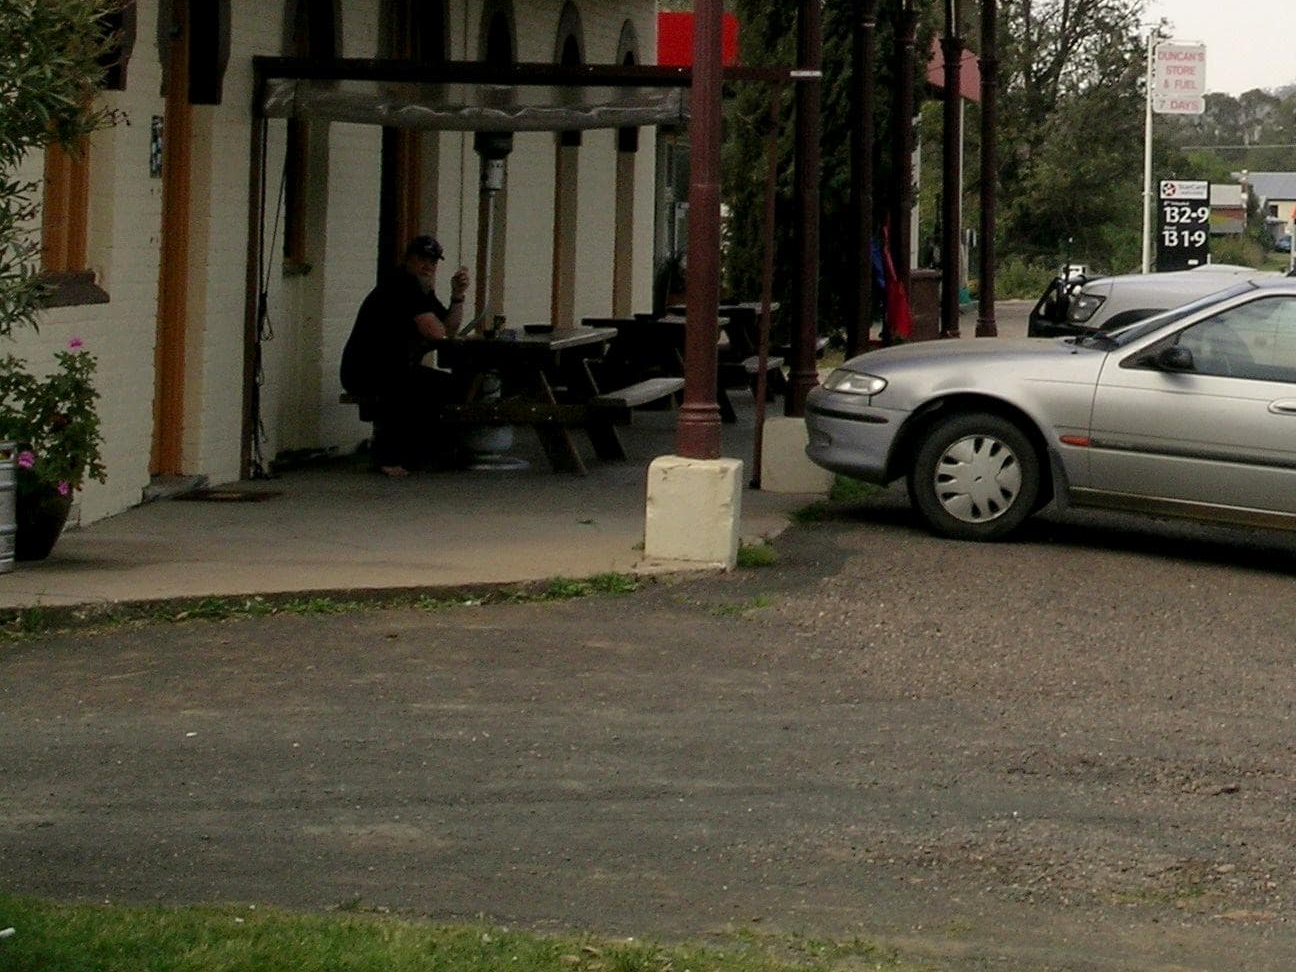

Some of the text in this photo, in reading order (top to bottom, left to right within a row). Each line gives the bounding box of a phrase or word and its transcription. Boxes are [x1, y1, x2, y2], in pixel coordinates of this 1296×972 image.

[1157, 51, 1205, 62] DUNCAN'S
[1166, 65, 1196, 76] STORE
[1174, 80, 1197, 90] FUEL
[1170, 100, 1199, 110] DAYS
